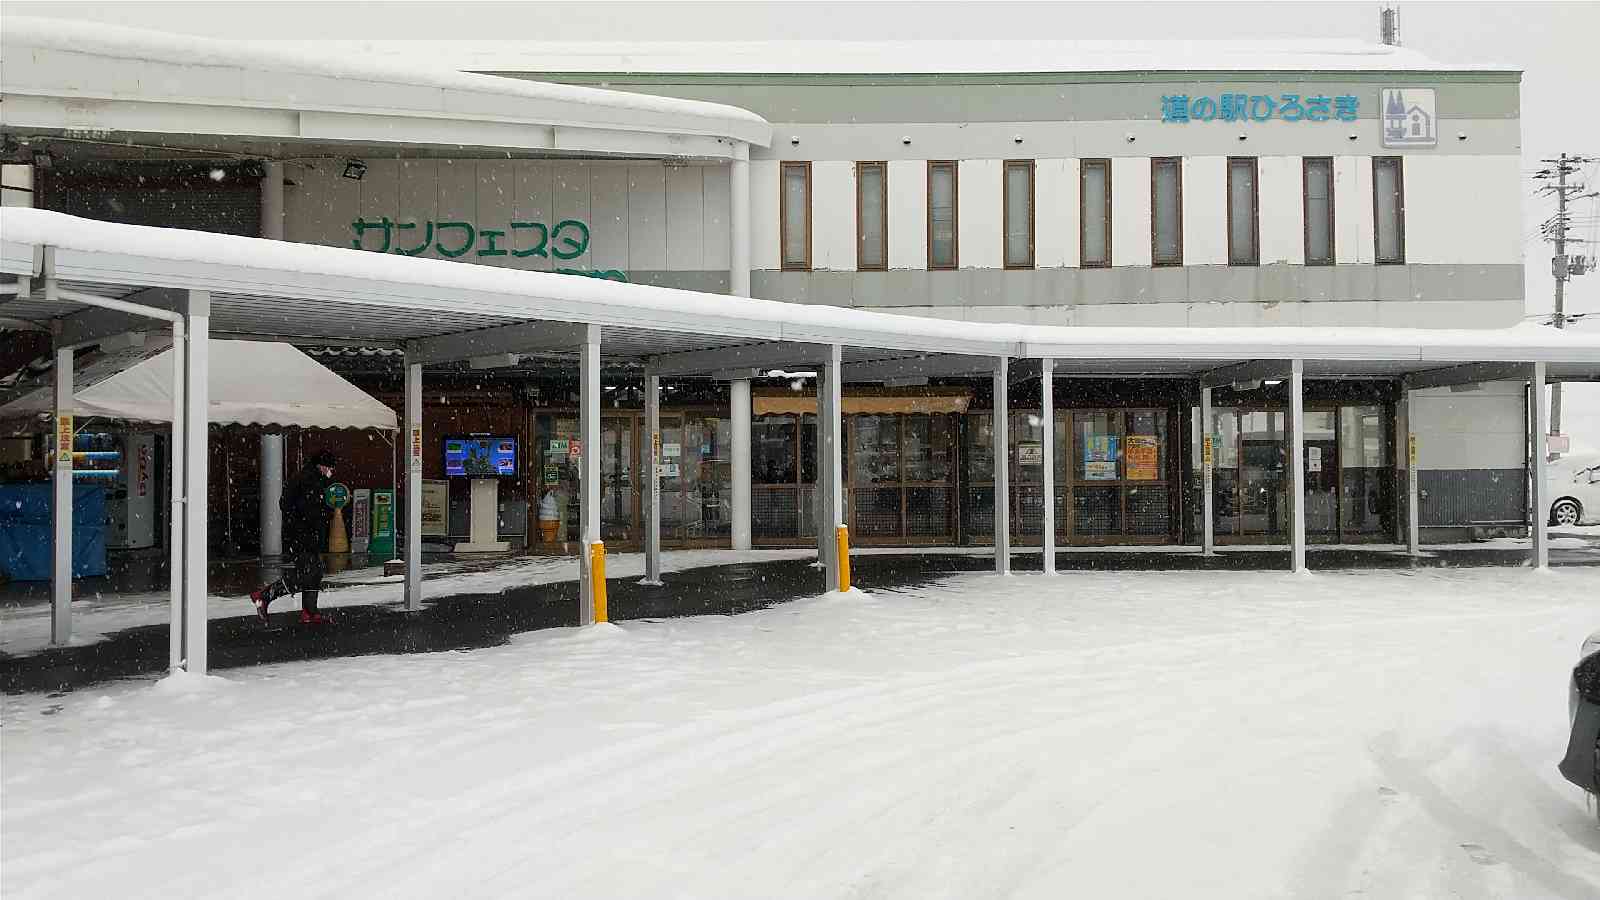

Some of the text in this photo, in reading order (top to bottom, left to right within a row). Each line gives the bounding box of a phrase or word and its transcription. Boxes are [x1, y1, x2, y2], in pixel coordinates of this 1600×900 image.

[1161, 94, 1360, 123] 道の駅ひろさき
[352, 217, 589, 259] サンフェスタ
